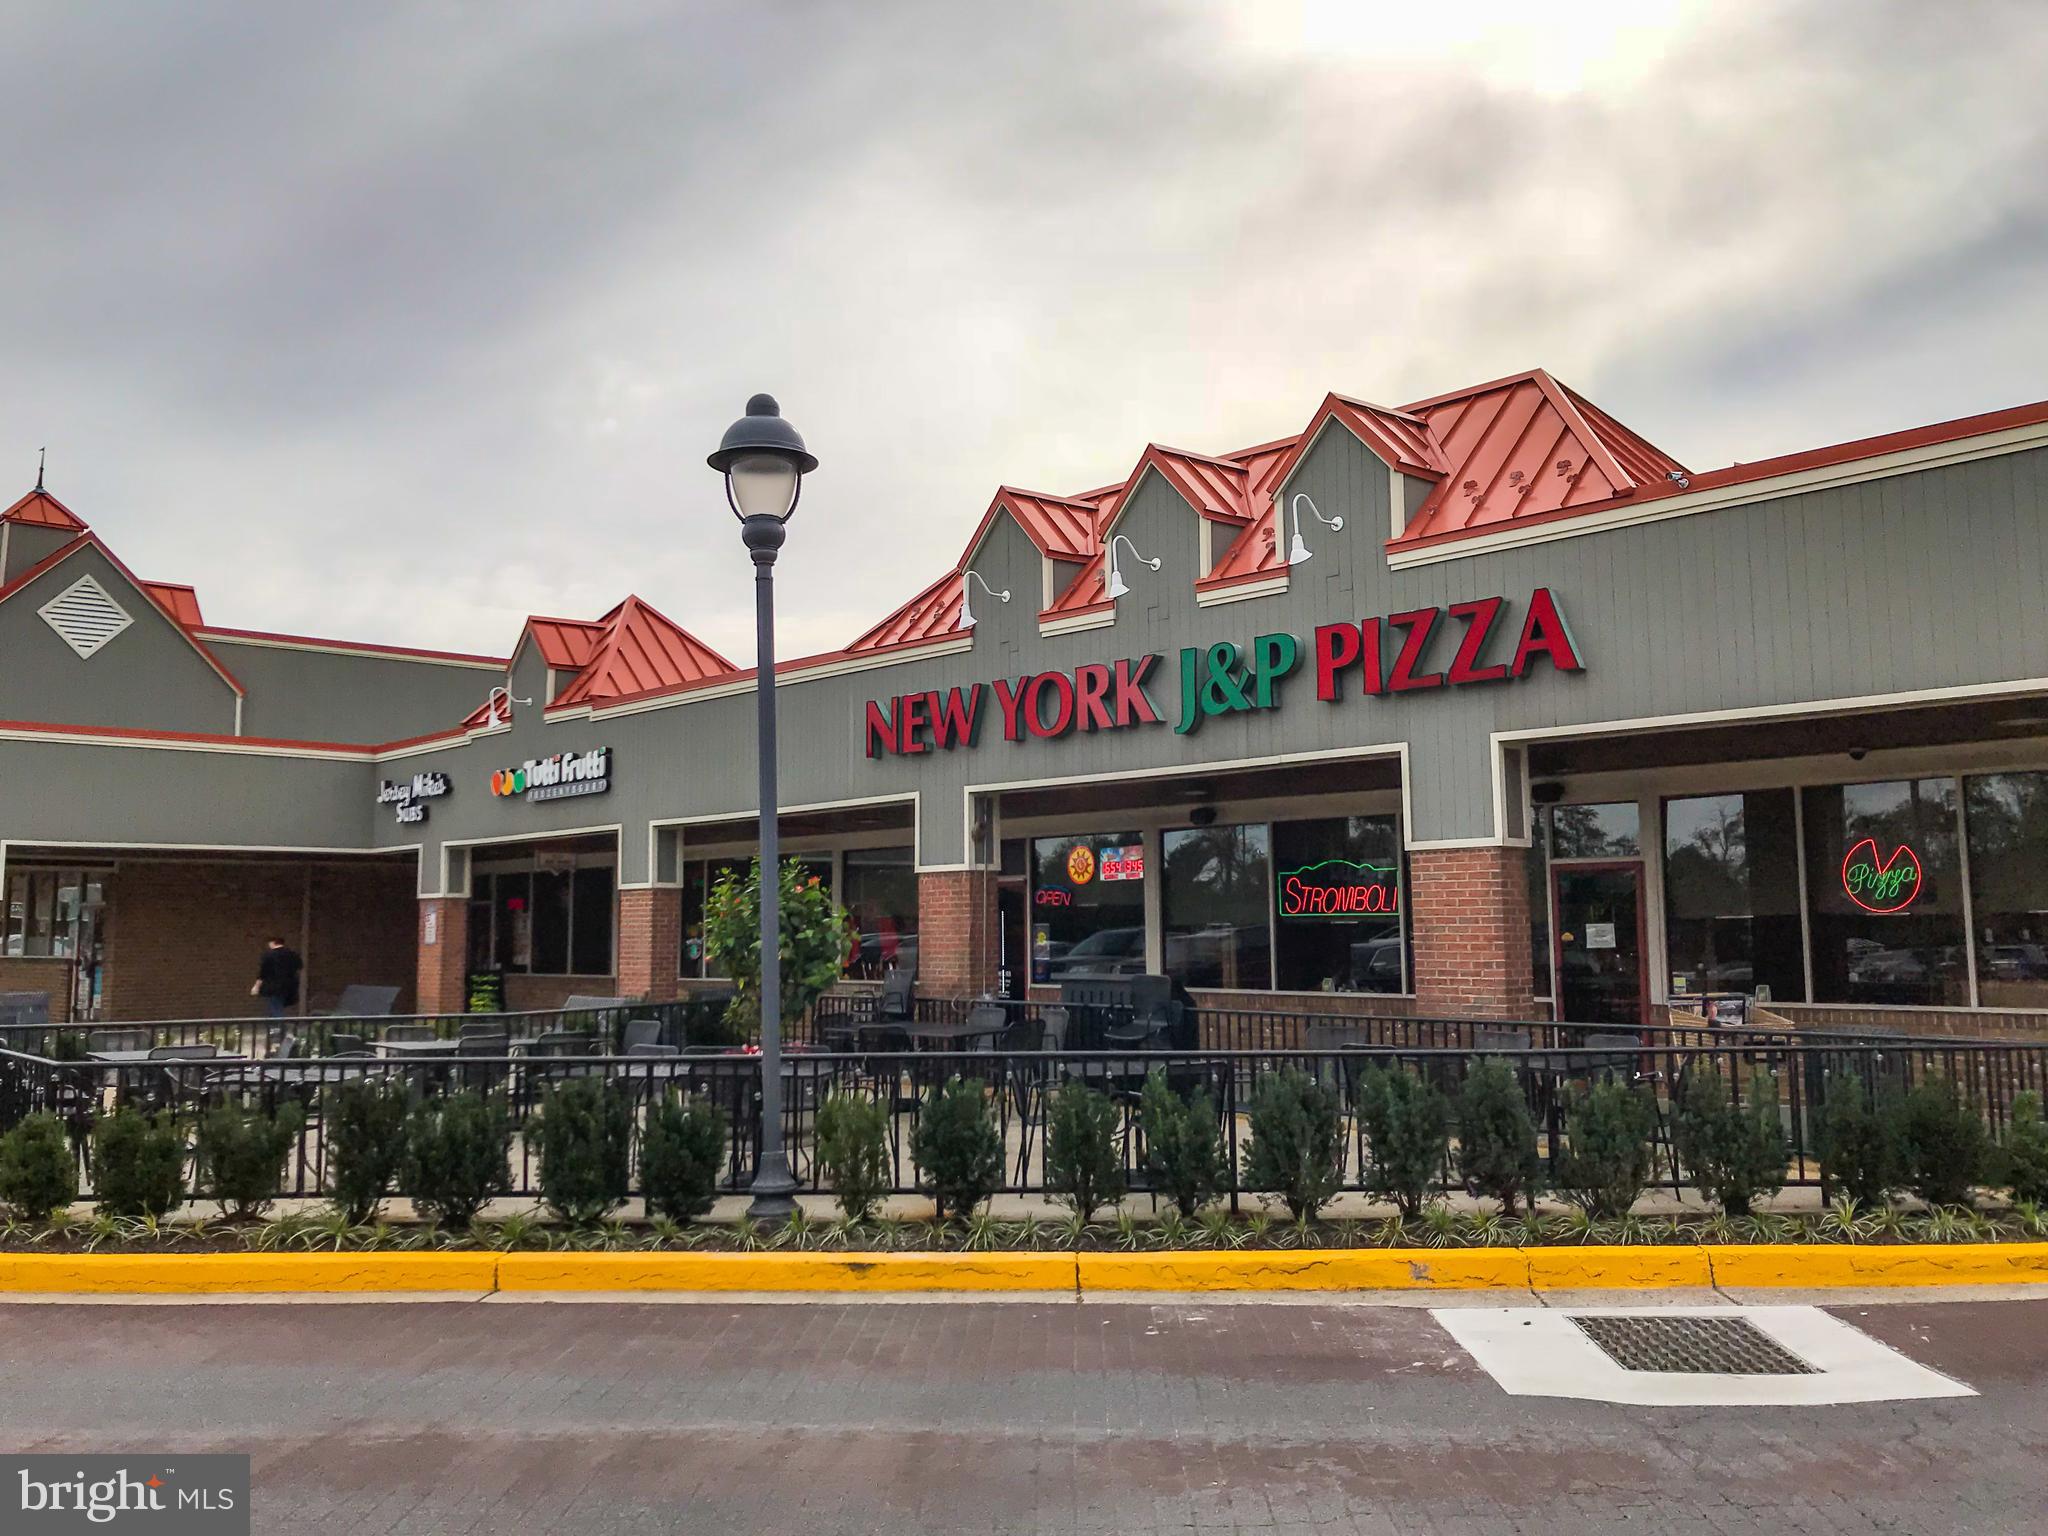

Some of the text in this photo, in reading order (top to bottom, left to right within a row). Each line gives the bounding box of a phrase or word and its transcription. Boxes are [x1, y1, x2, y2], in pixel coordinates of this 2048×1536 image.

[866, 587, 1586, 759] NEW YORK J&P PIZZA
[523, 754, 561, 787] Tutti
[1035, 890, 1072, 906] OPEN
[1285, 877, 1399, 914] STROMBOLI
[1847, 863, 1918, 900] Pizza
